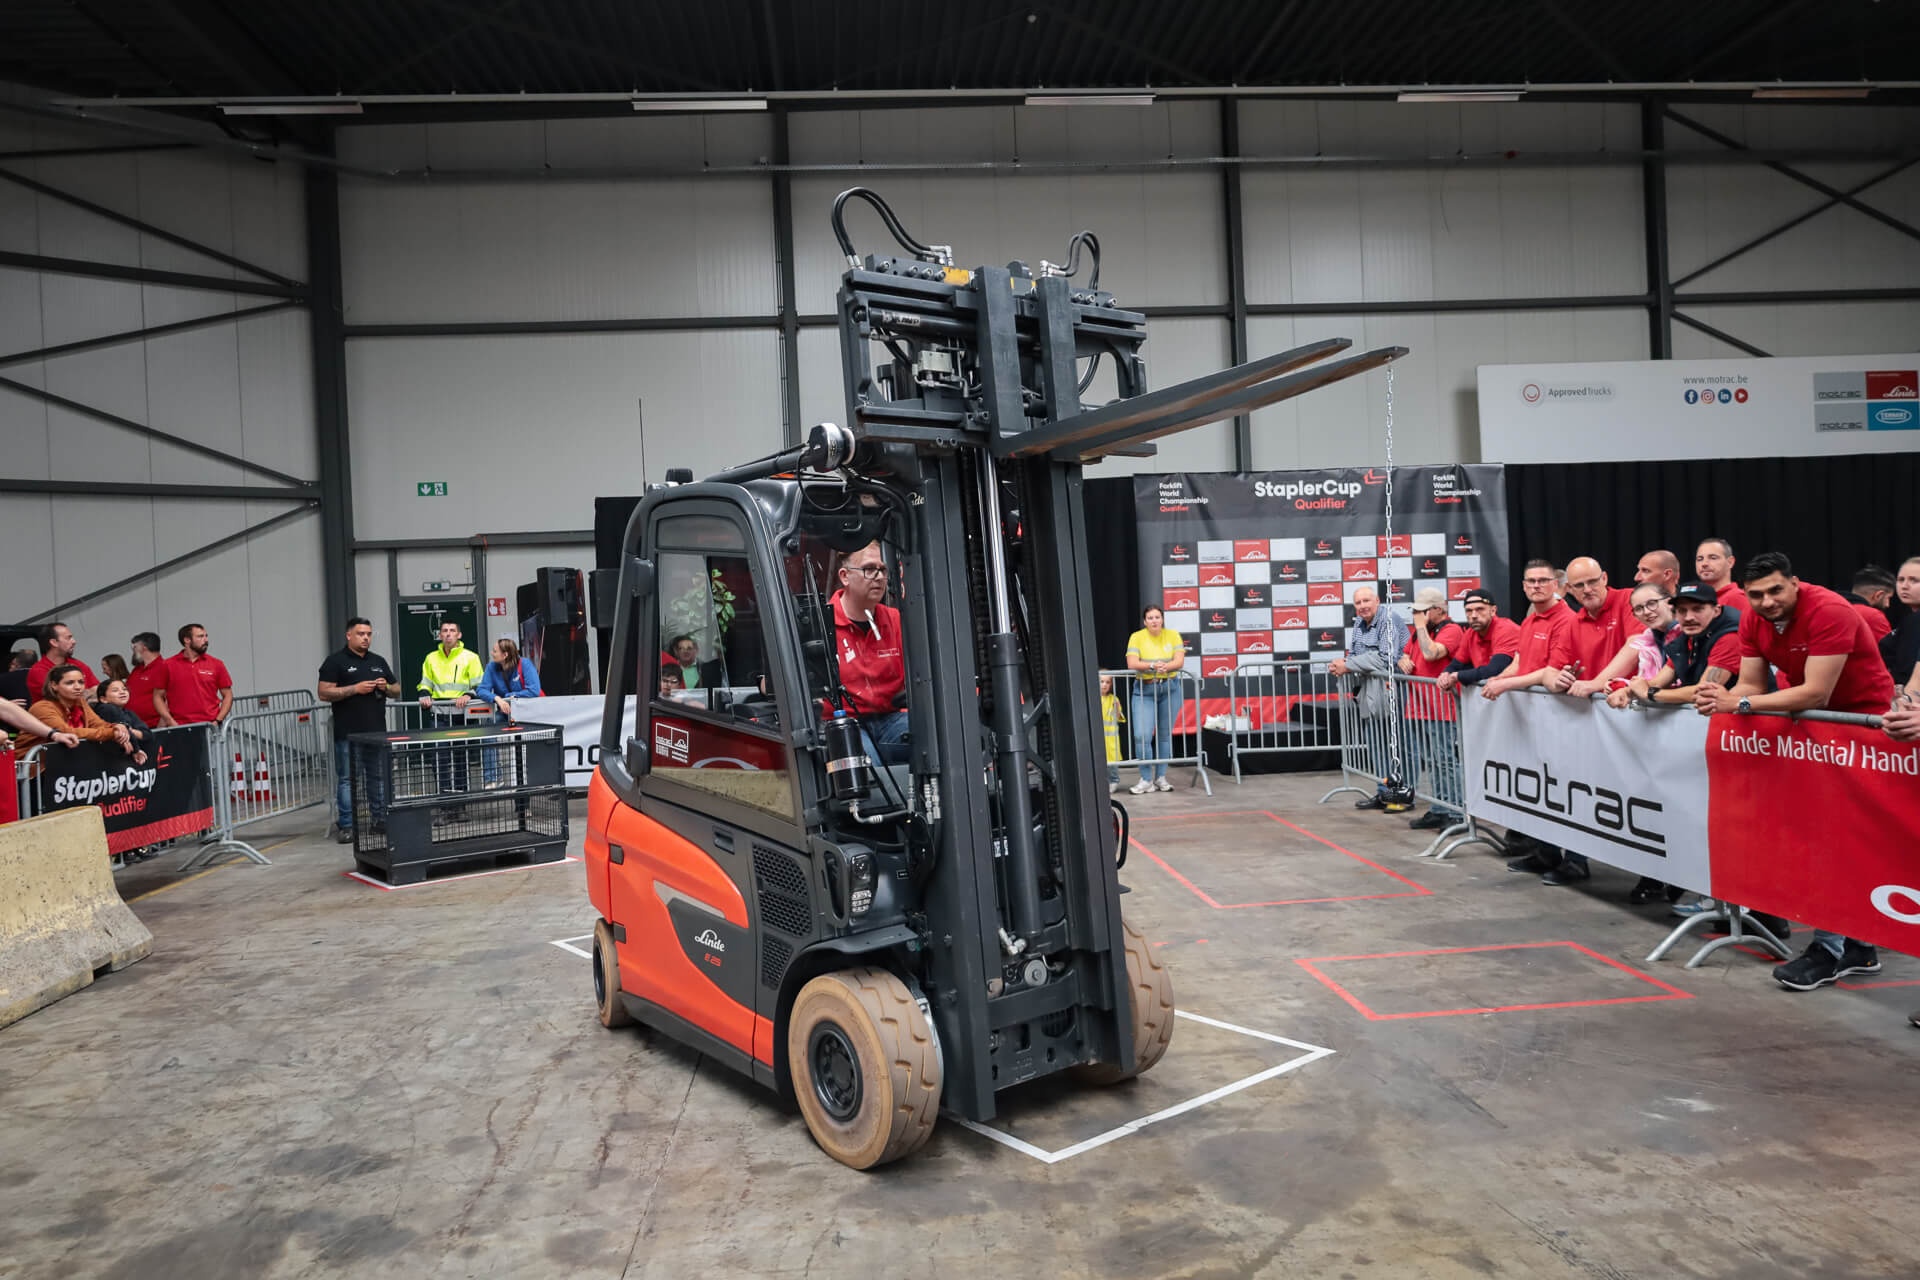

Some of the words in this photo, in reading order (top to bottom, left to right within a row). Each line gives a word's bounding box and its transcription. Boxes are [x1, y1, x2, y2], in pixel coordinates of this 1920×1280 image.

[1682, 374, 1748, 384] www.motrac.be
[1254, 480, 1361, 500] StaplerCup
[1433, 488, 1482, 496] Championship
[1159, 497, 1209, 505] Championship
[1294, 498, 1347, 510] Qualifier
[1720, 729, 1771, 755] Linde
[1776, 735, 1854, 767] Material
[1861, 744, 1920, 776] Hand
[54, 766, 157, 804] StaplerCup
[1484, 760, 1666, 844] motrac
[694, 929, 725, 952] Linde
